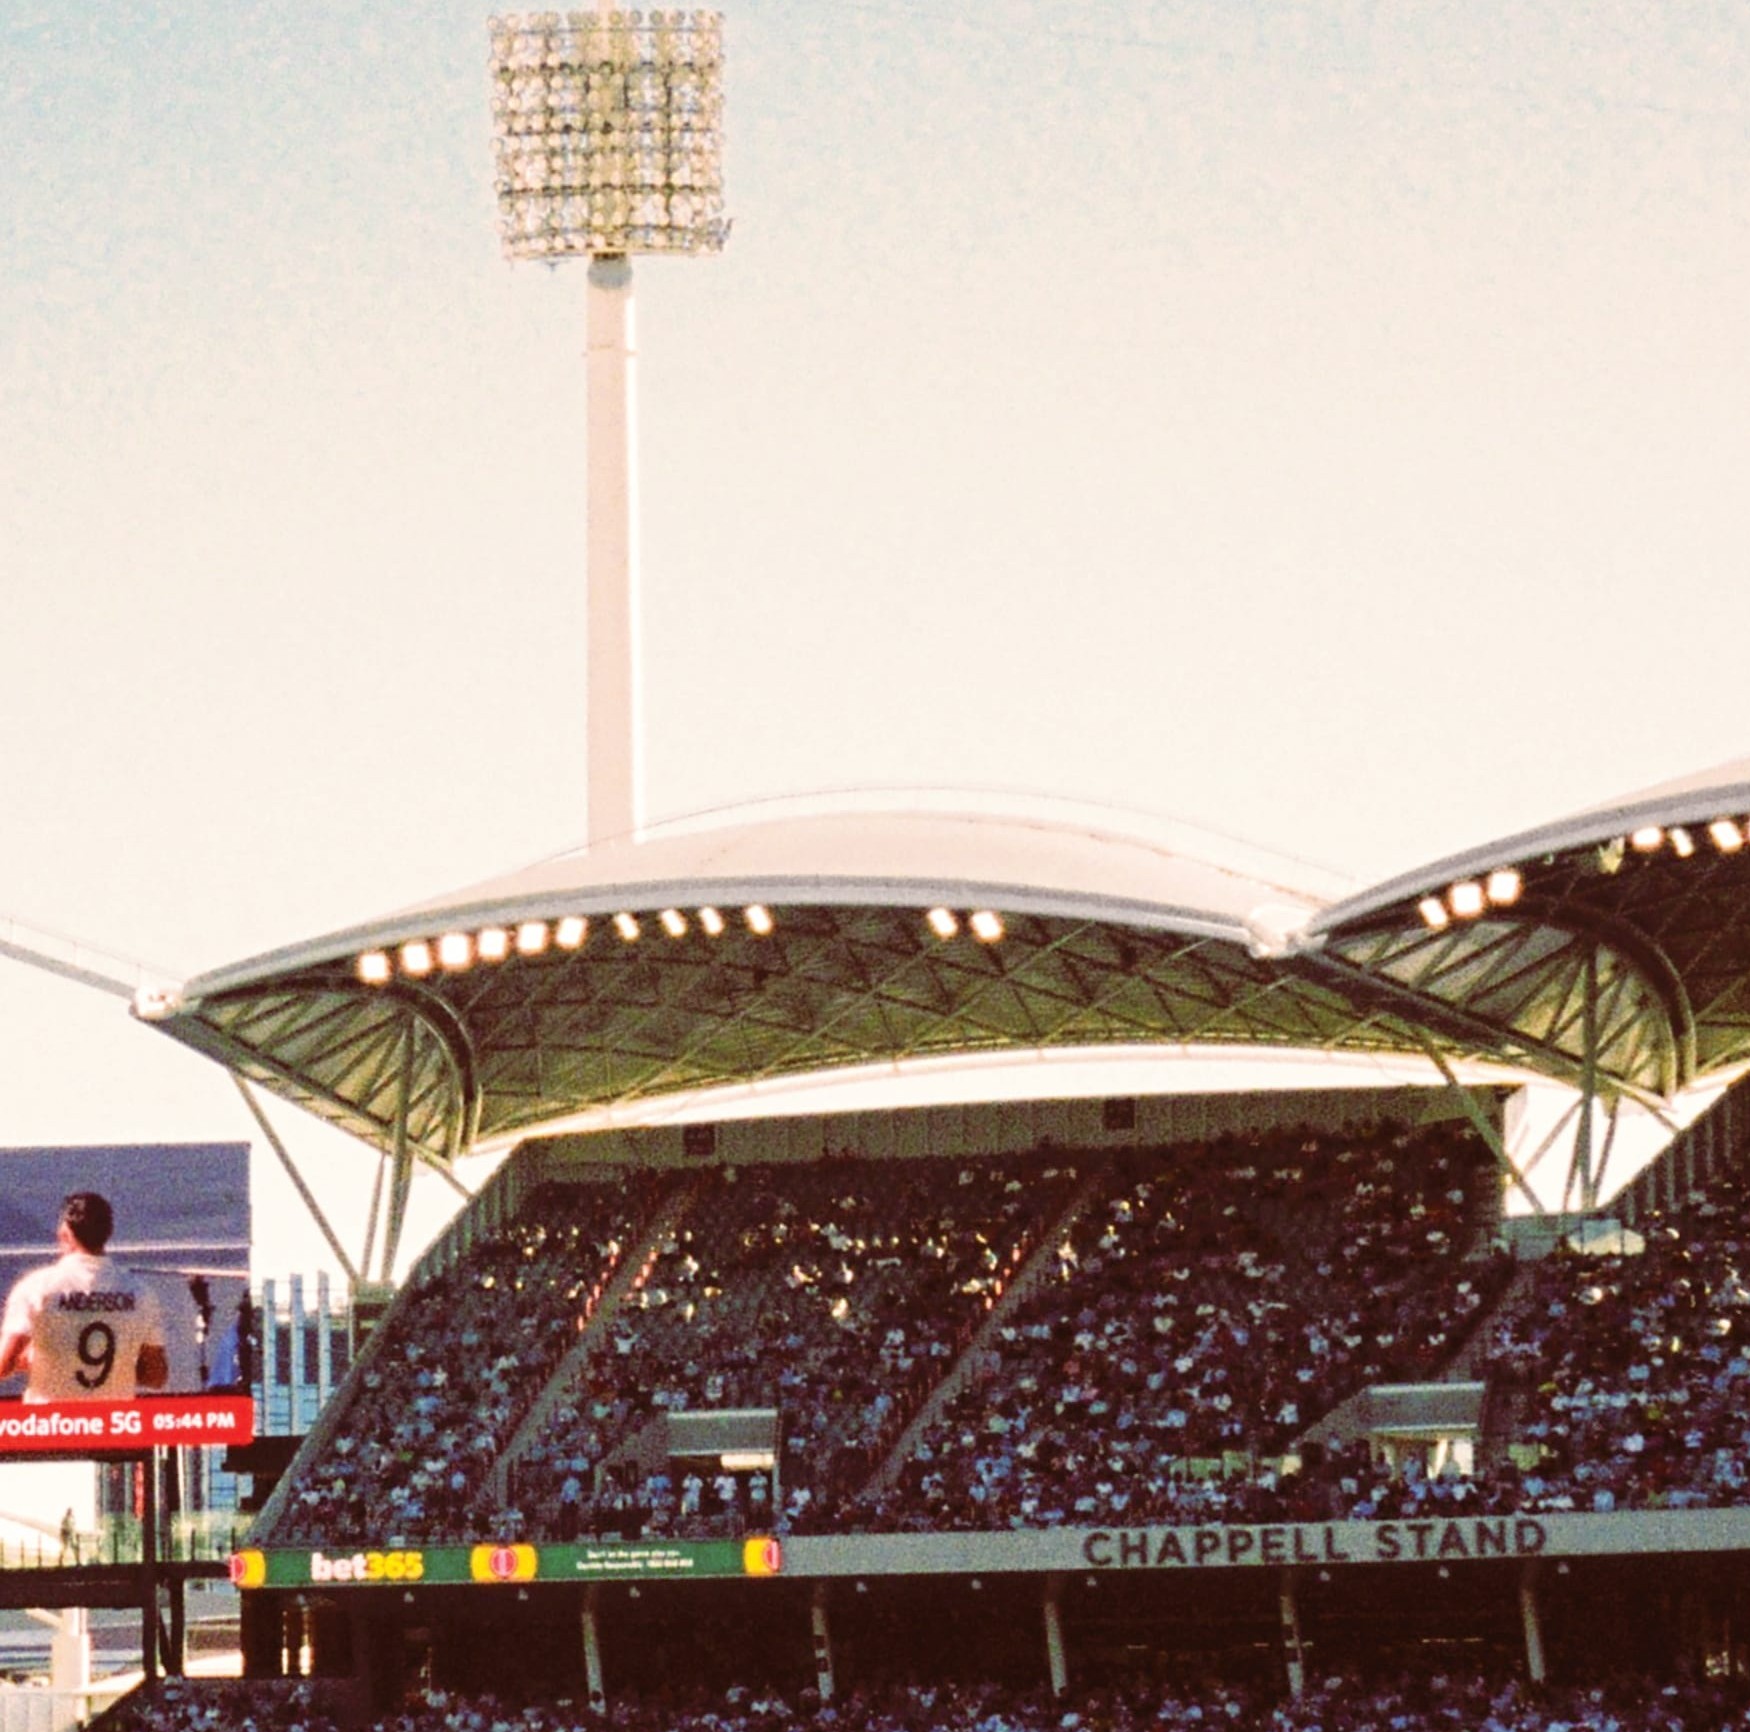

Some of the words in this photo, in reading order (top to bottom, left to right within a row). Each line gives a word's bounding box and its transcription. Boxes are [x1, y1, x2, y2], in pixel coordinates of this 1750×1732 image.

[59, 1291, 135, 1312] ANDERSON
[75, 1321, 117, 1390] 9
[110, 1411, 143, 1435] 5G
[153, 1413, 203, 1431] 05:44
[207, 1412, 236, 1429] PM
[1083, 1530, 1351, 1568] CHAPPELL
[1376, 1520, 1549, 1562] STAND
[311, 1552, 425, 1582] bet365
